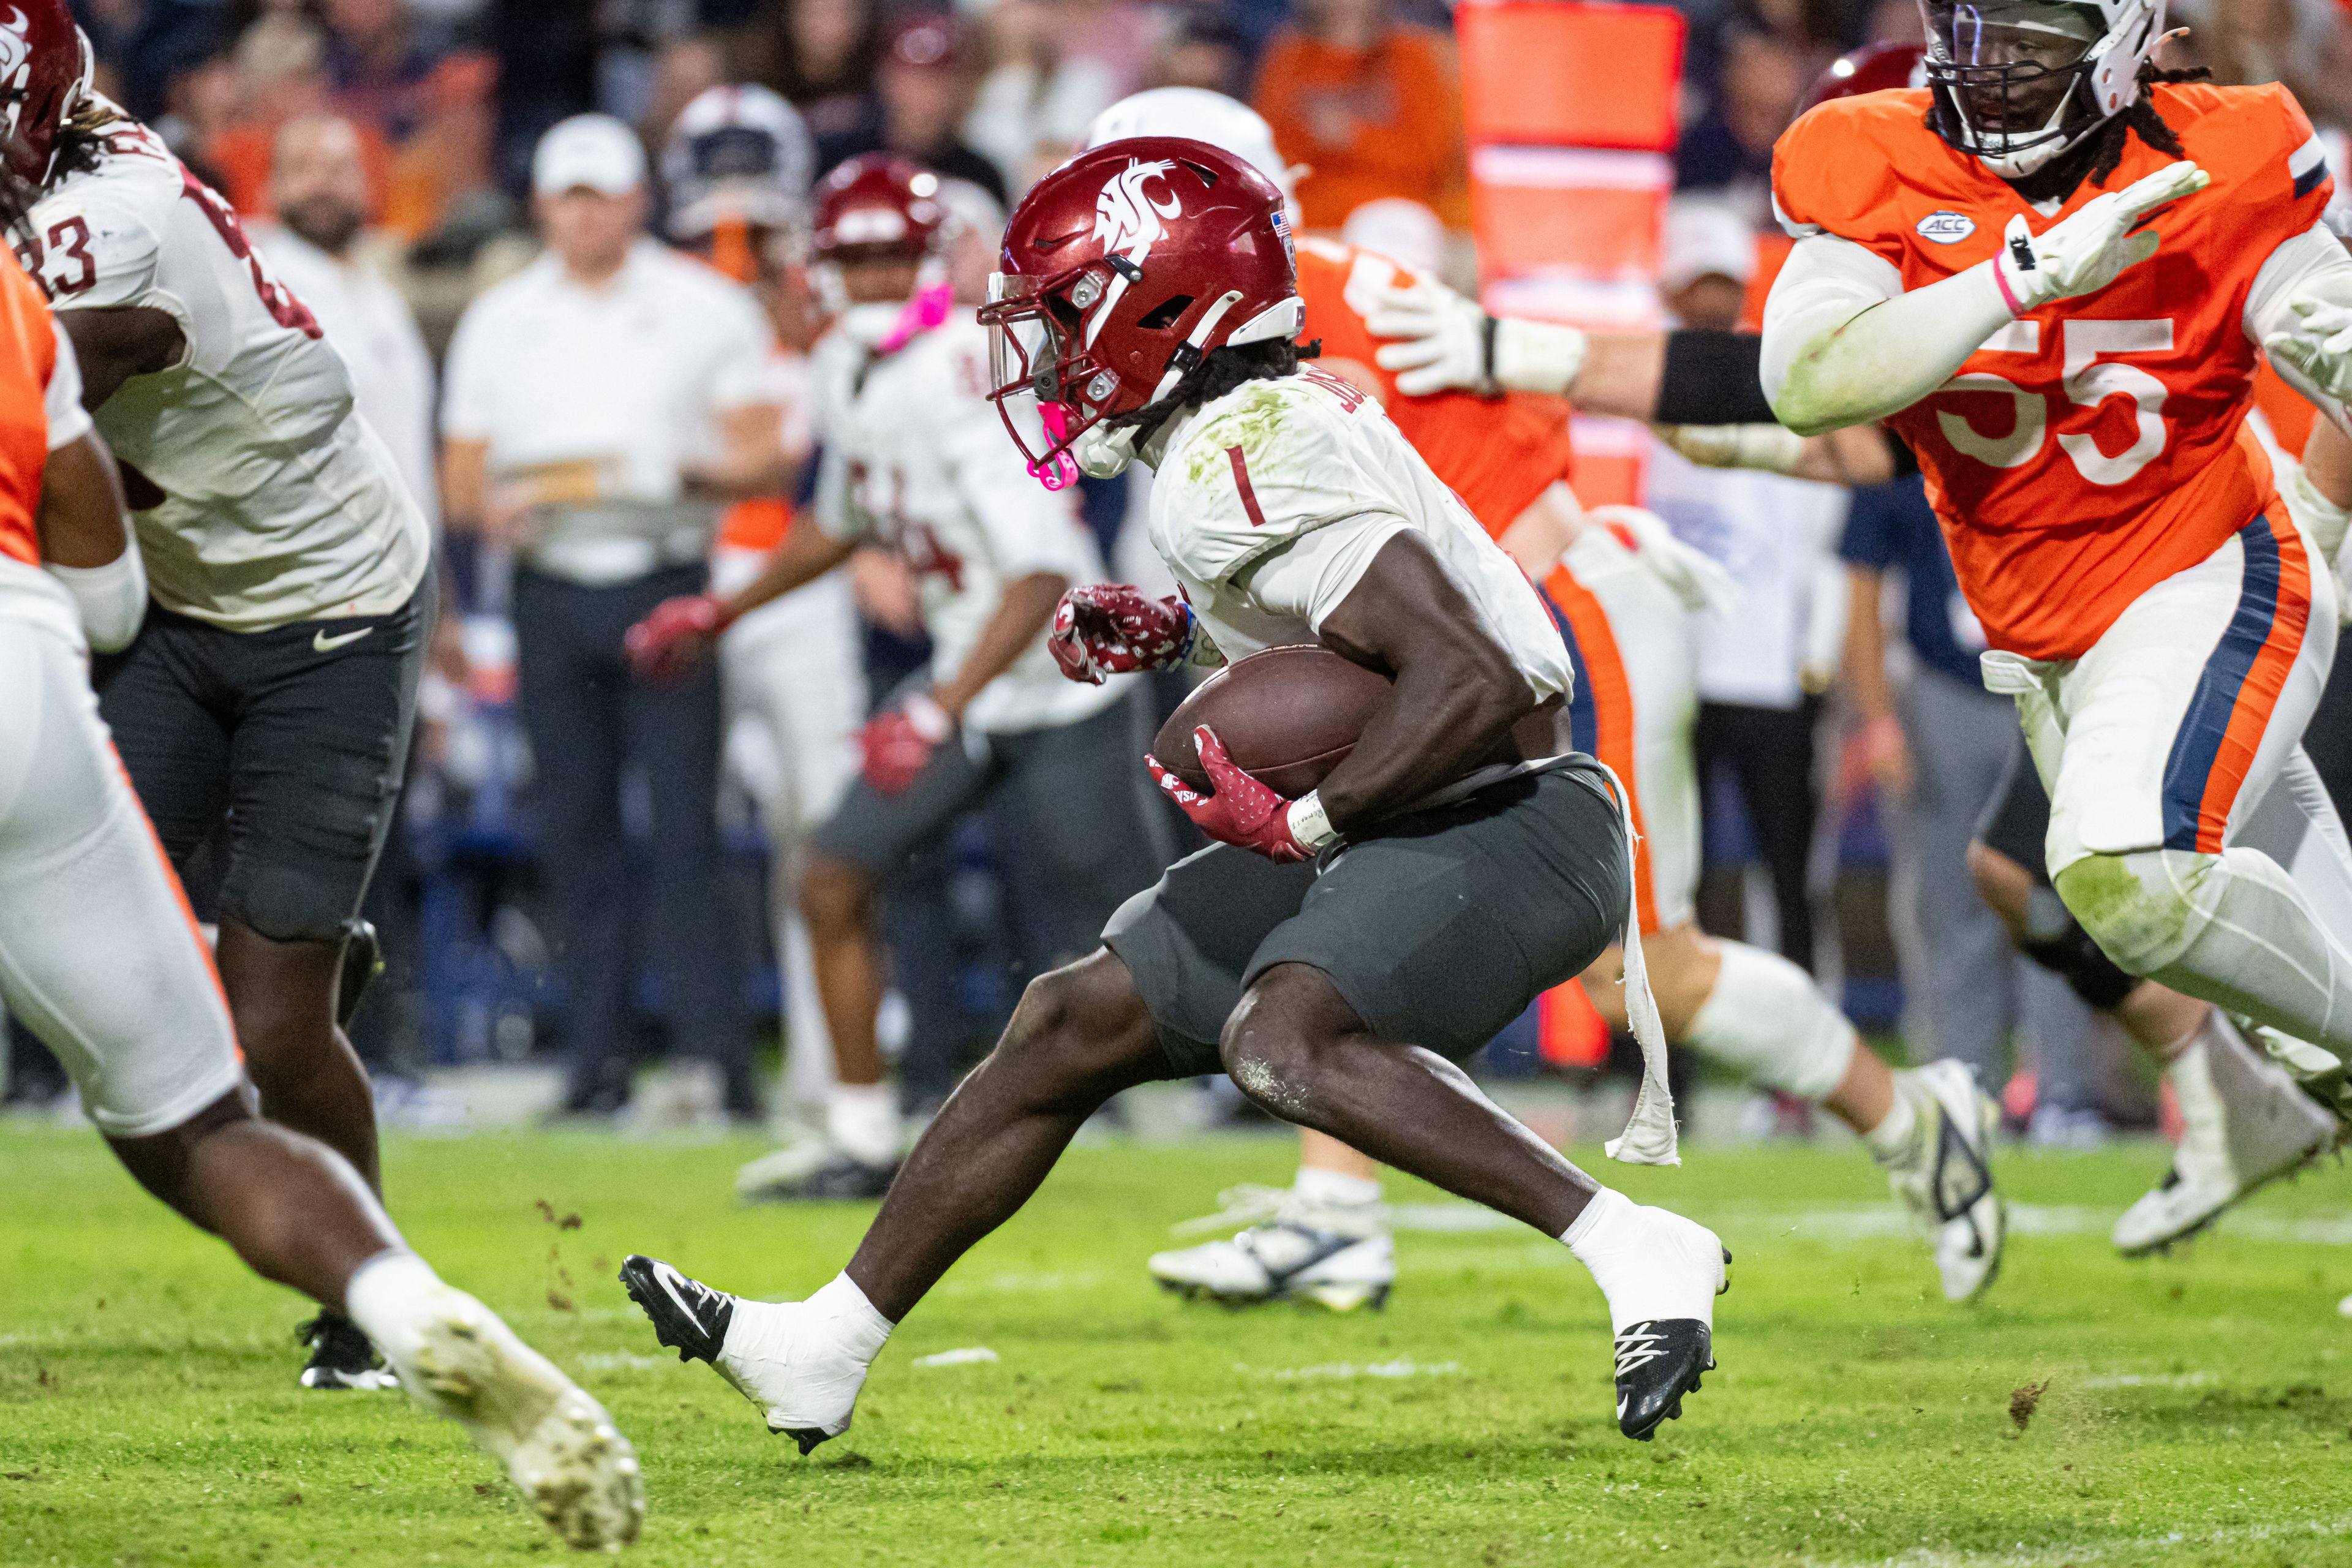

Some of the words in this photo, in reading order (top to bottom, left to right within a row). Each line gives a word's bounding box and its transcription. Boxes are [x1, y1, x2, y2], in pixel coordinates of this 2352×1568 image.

[1925, 219, 1966, 230] ACC
[1934, 317, 2174, 485] 55
[1224, 444, 1267, 527] 1
